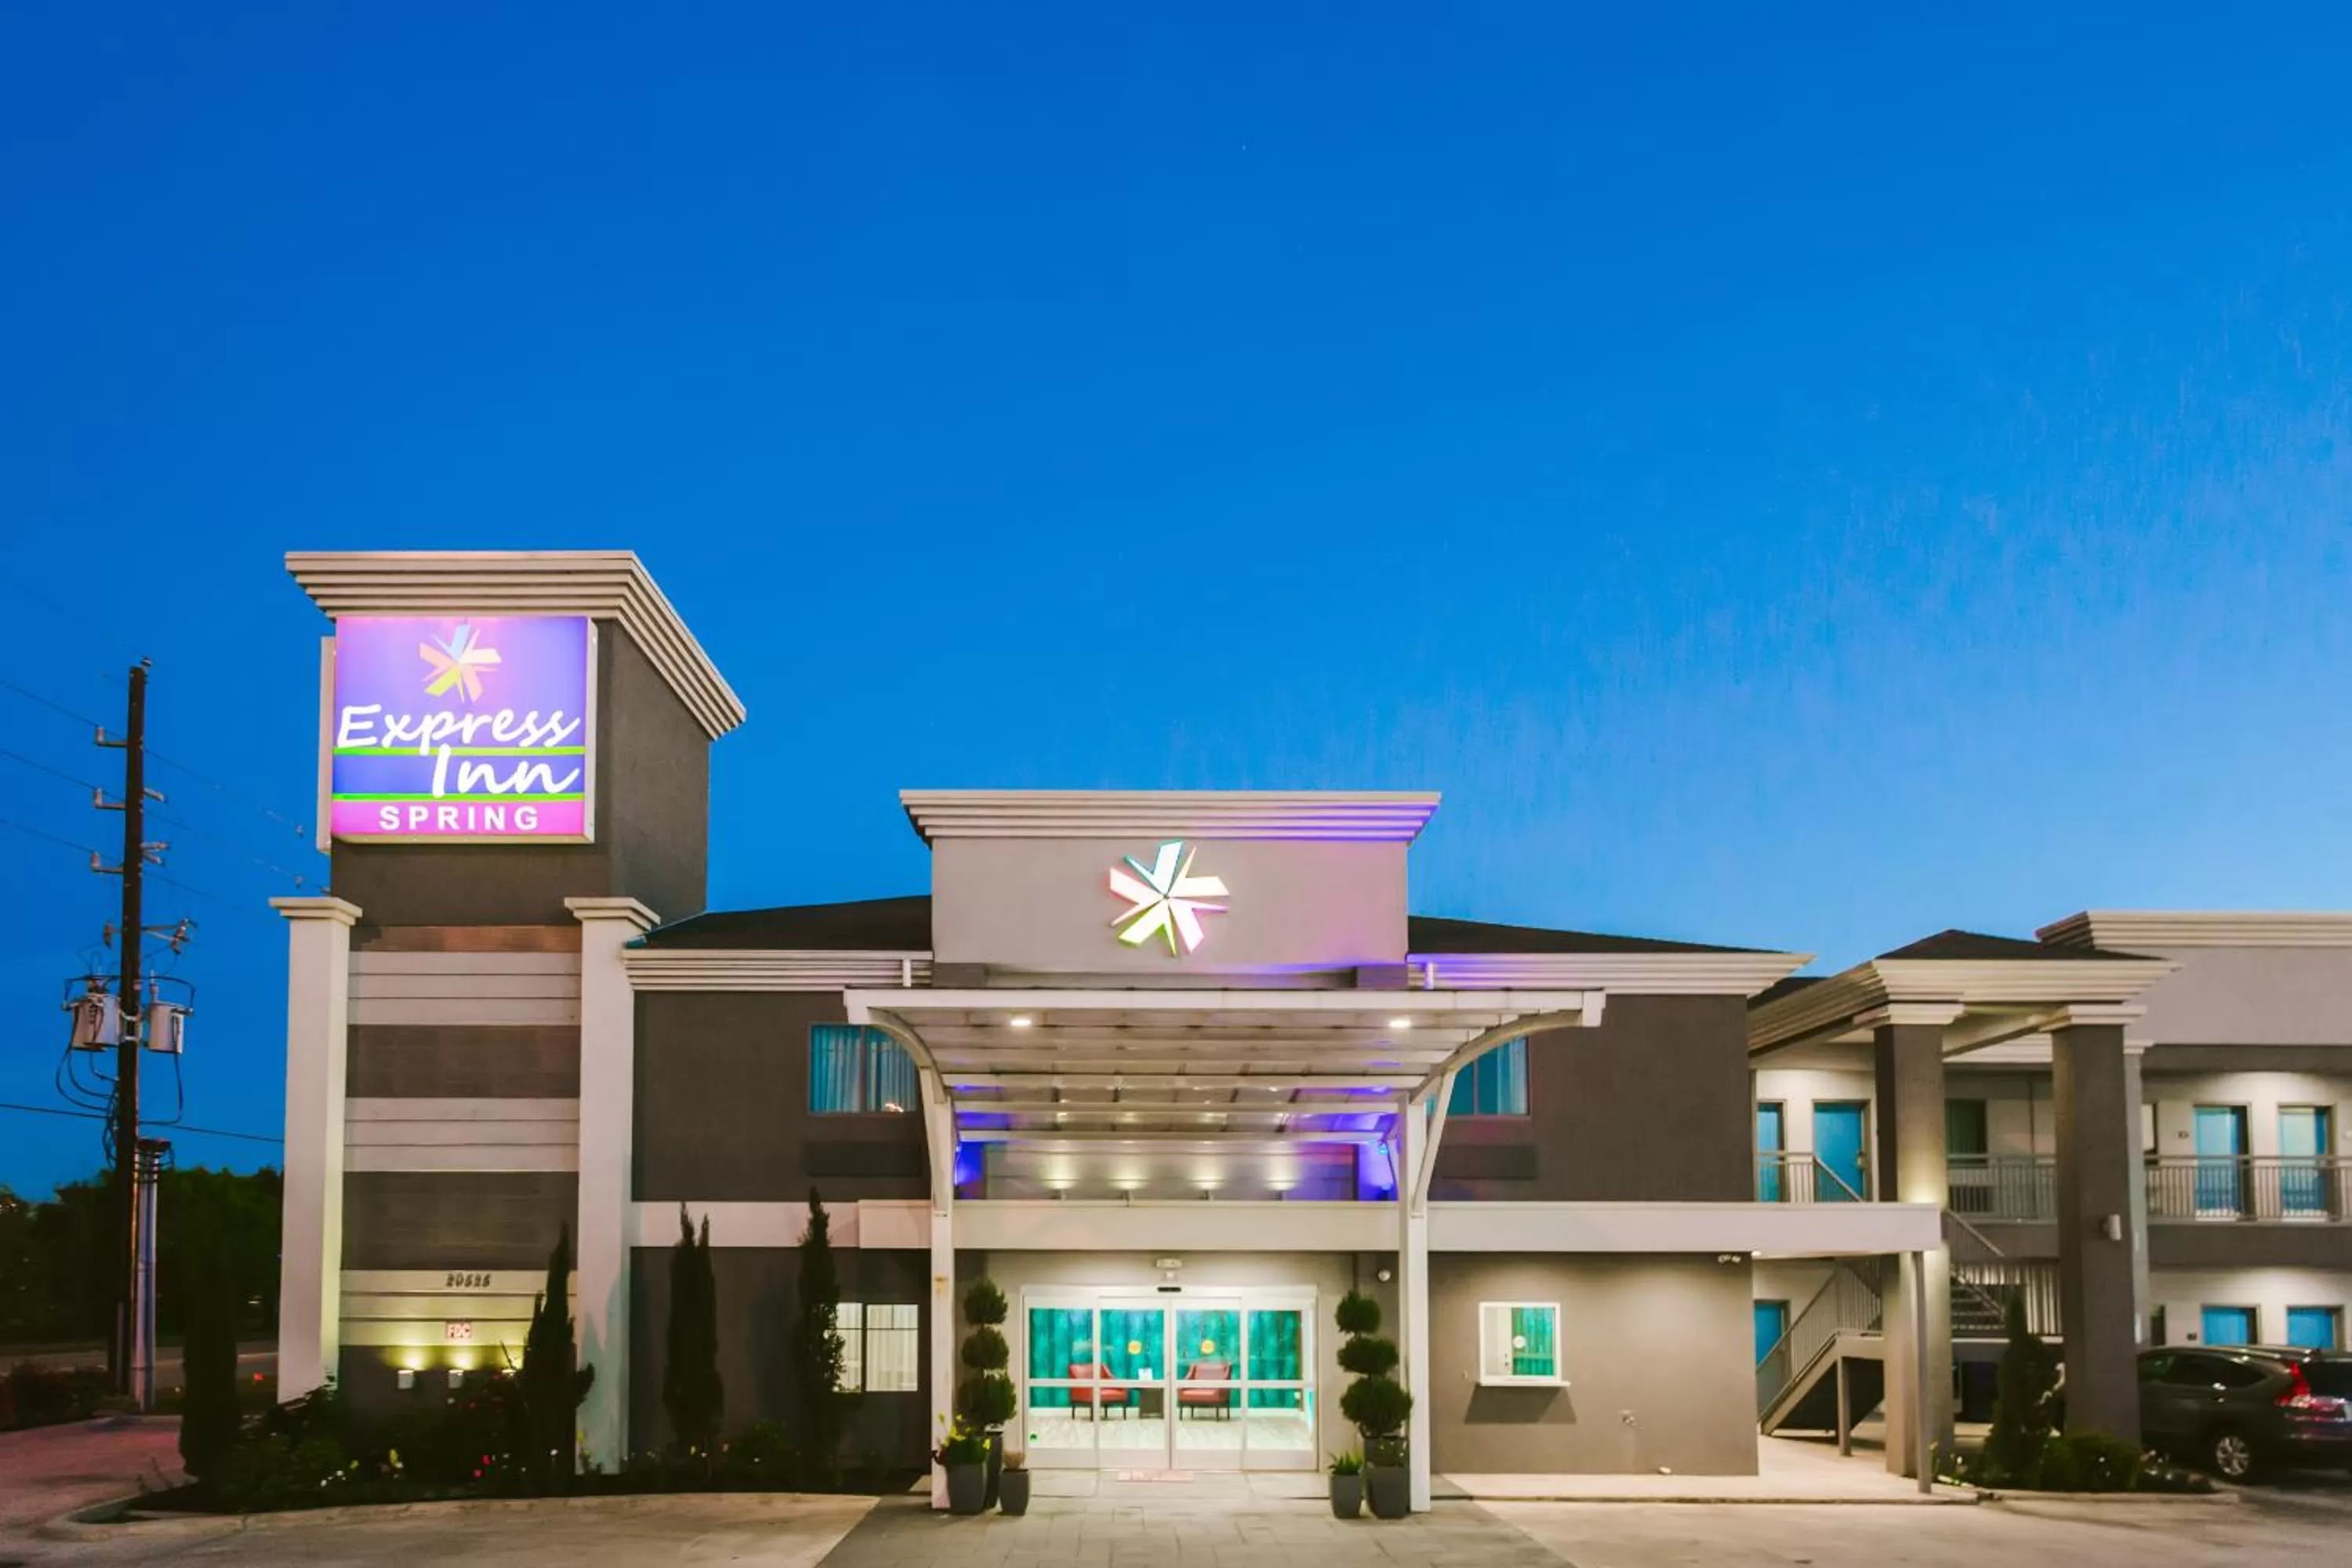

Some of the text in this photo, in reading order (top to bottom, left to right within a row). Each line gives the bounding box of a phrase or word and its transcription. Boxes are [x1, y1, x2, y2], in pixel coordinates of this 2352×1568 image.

[336, 703, 581, 757] Express
[431, 742, 580, 798] Inn
[379, 804, 539, 830] SPRING
